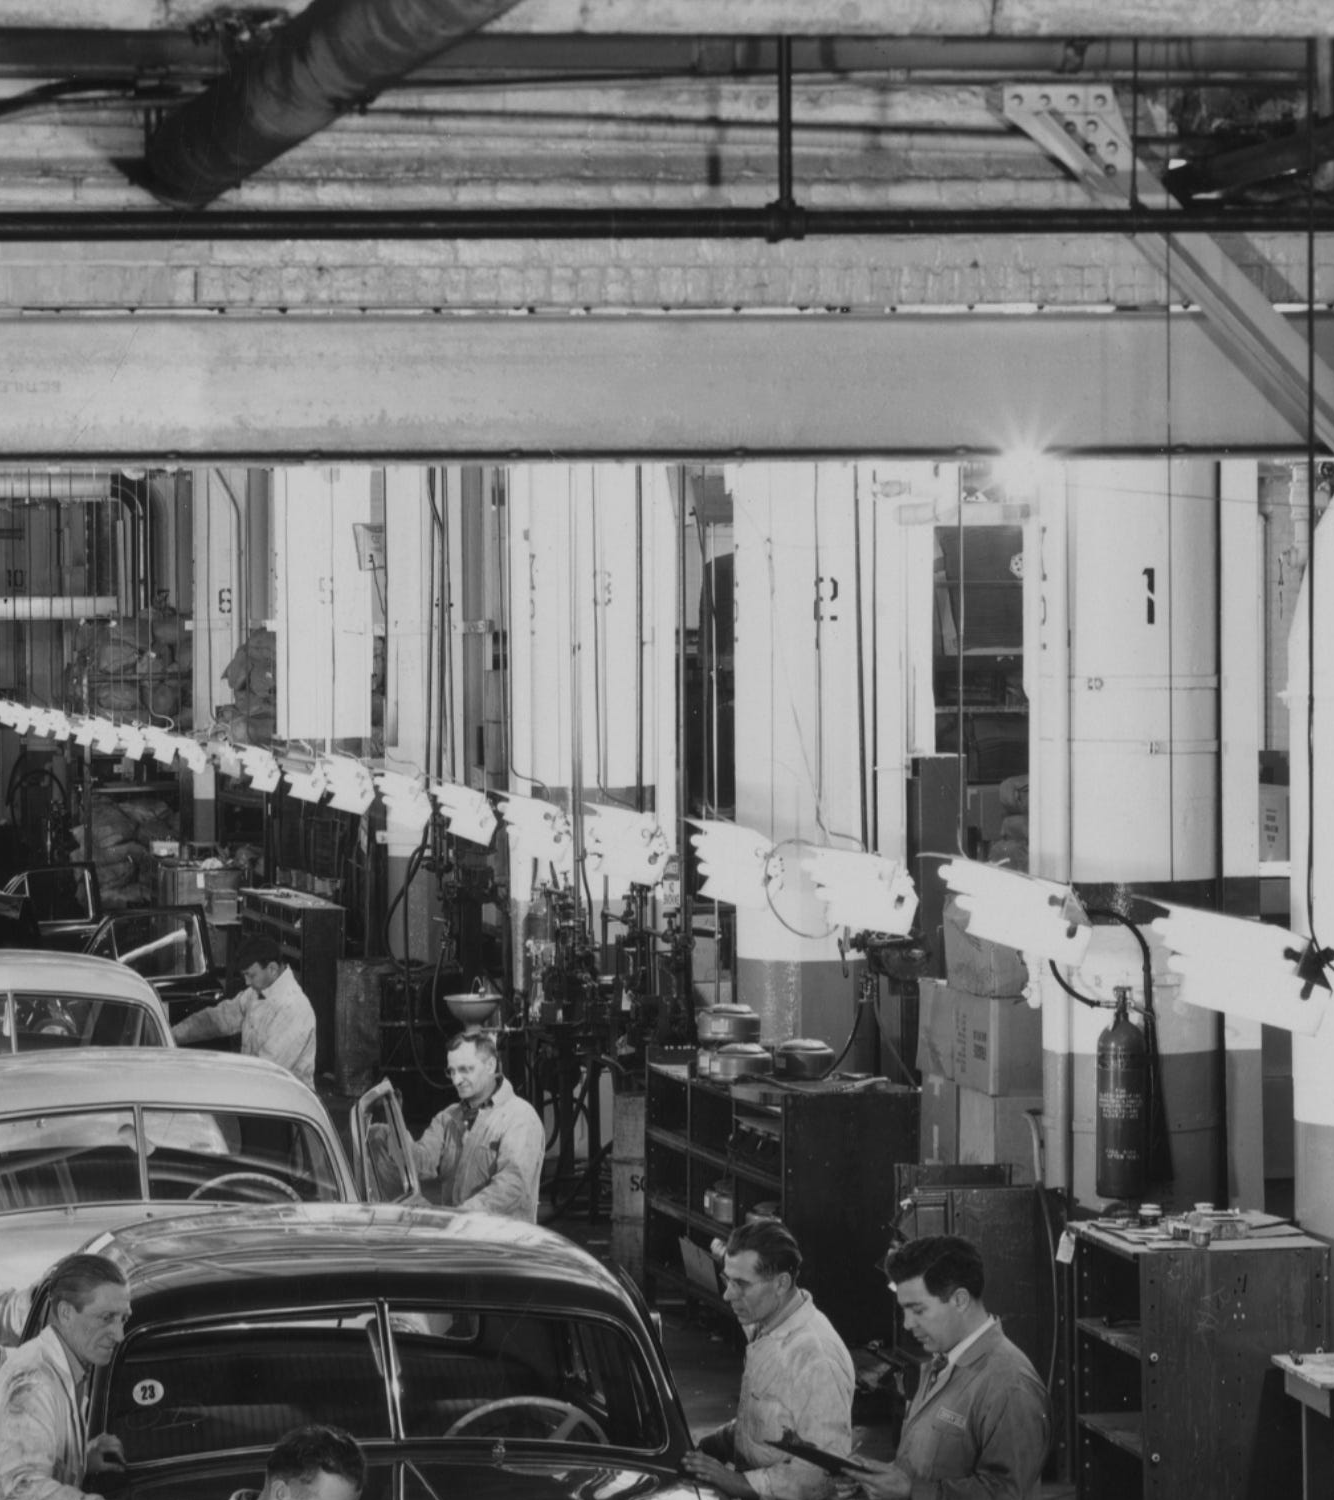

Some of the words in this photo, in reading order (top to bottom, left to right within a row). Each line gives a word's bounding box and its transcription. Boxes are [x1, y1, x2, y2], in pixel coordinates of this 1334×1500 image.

[218, 588, 232, 614] 6
[813, 577, 838, 621] 2
[1141, 567, 1155, 625] 1
[140, 1384, 156, 1401] 23
